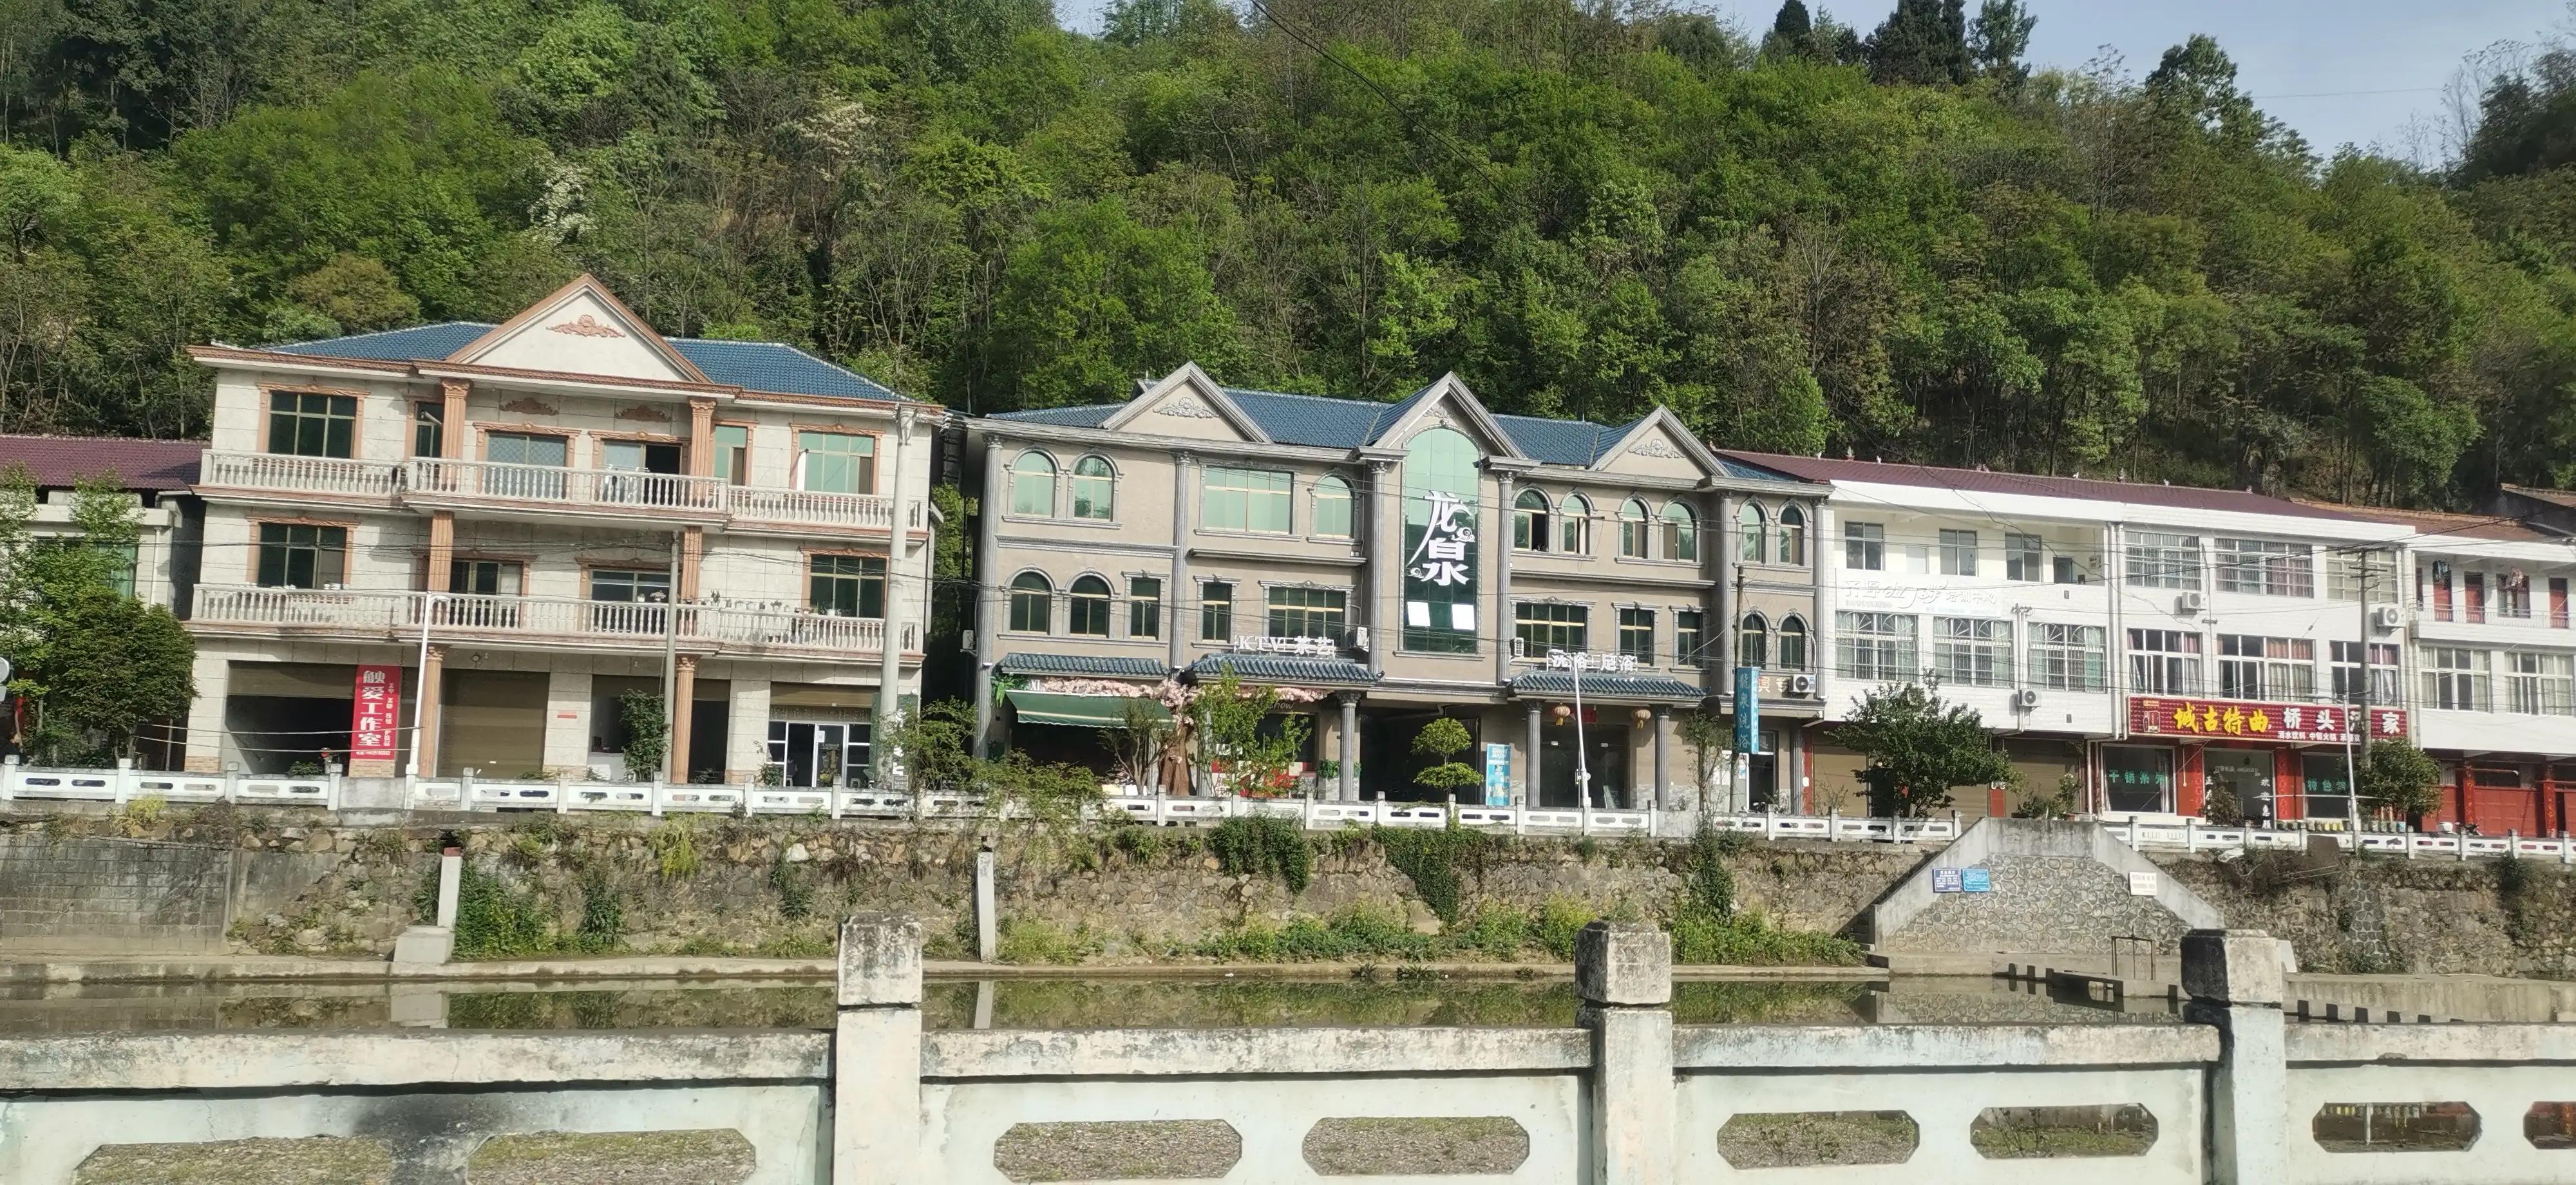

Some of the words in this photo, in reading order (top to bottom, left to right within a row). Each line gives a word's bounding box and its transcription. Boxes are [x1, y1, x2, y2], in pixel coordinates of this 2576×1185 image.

[1406, 490, 1473, 586] 龙泉
[1238, 635, 1285, 652] KTV
[2174, 702, 2269, 735] 城古特曲
